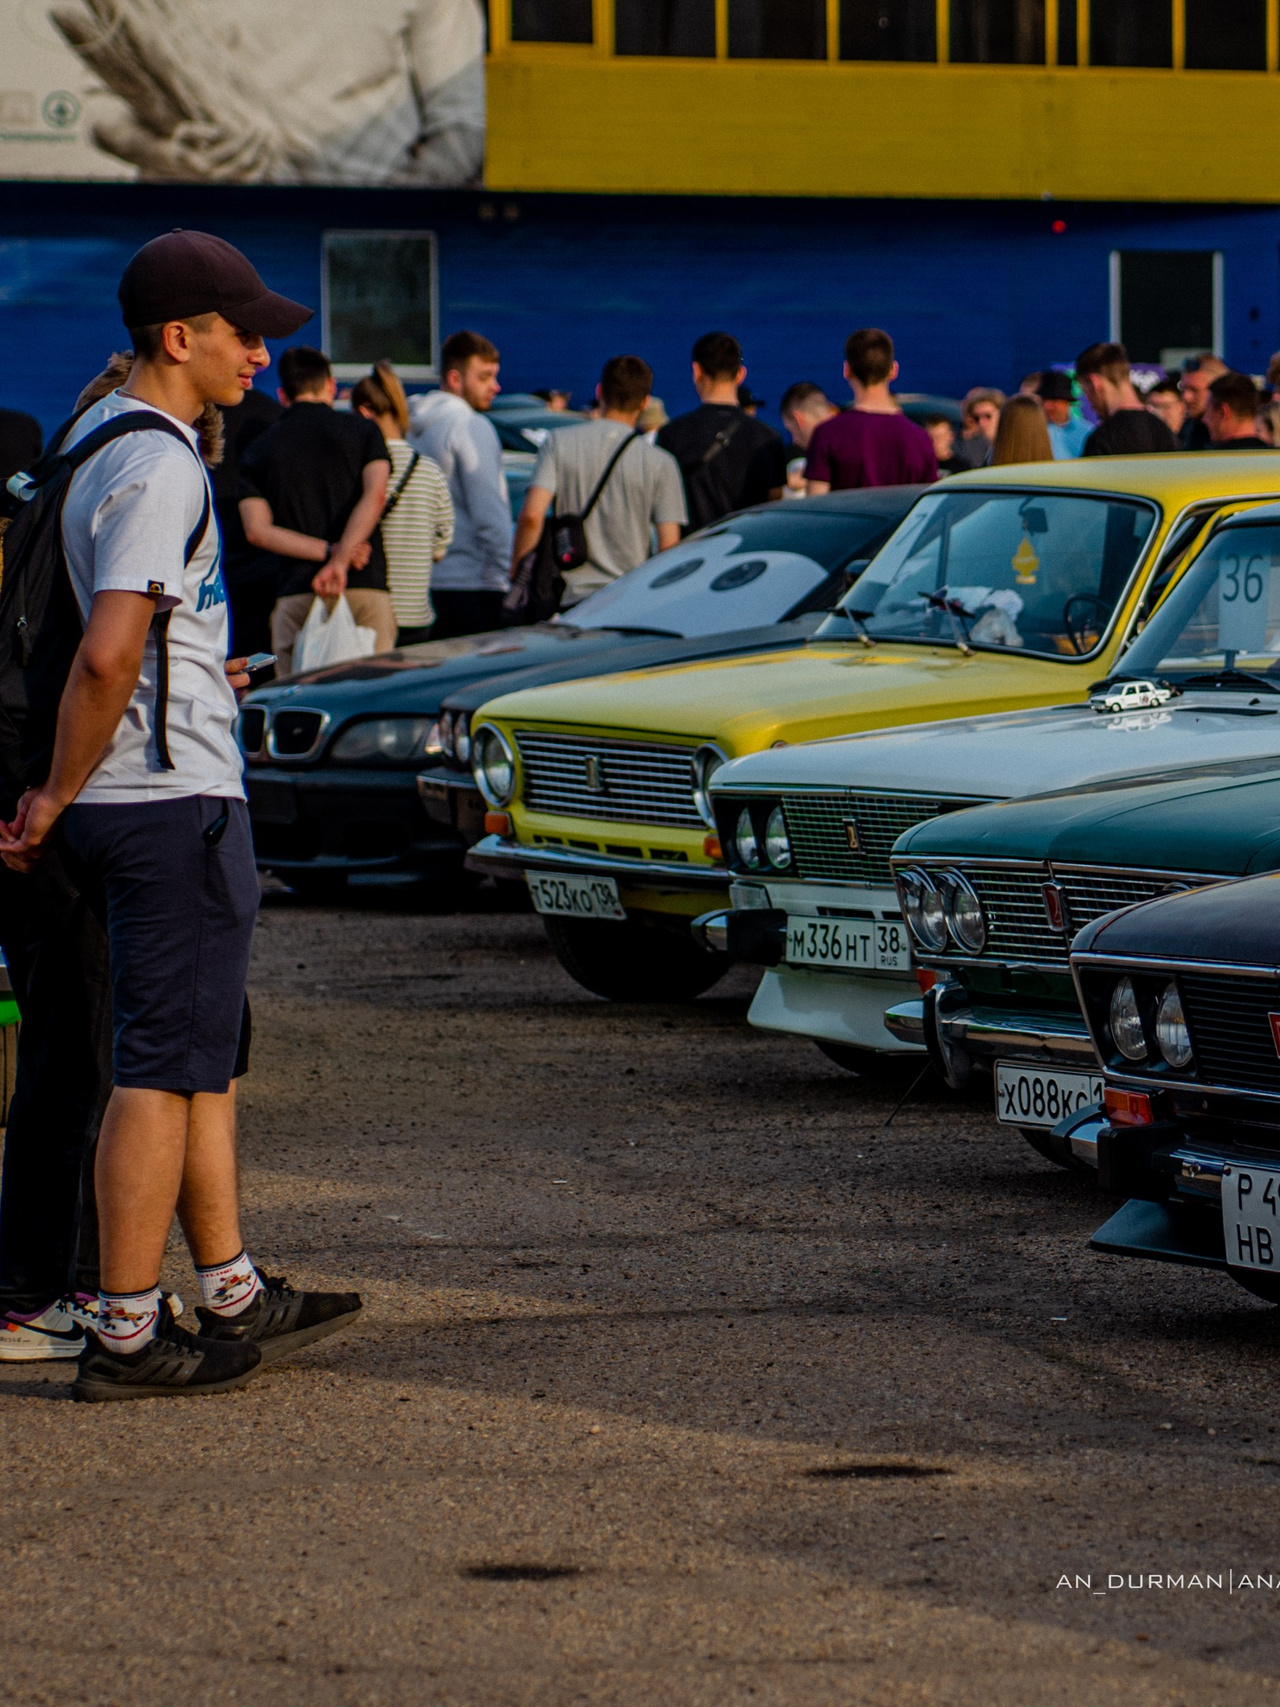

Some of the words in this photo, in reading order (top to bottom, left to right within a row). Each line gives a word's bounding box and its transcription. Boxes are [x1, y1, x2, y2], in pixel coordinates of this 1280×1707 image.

[1222, 554, 1263, 603] 36
[792, 922, 870, 962] М336НТ
[877, 926, 900, 953] 38
[881, 956, 898, 966] RUS
